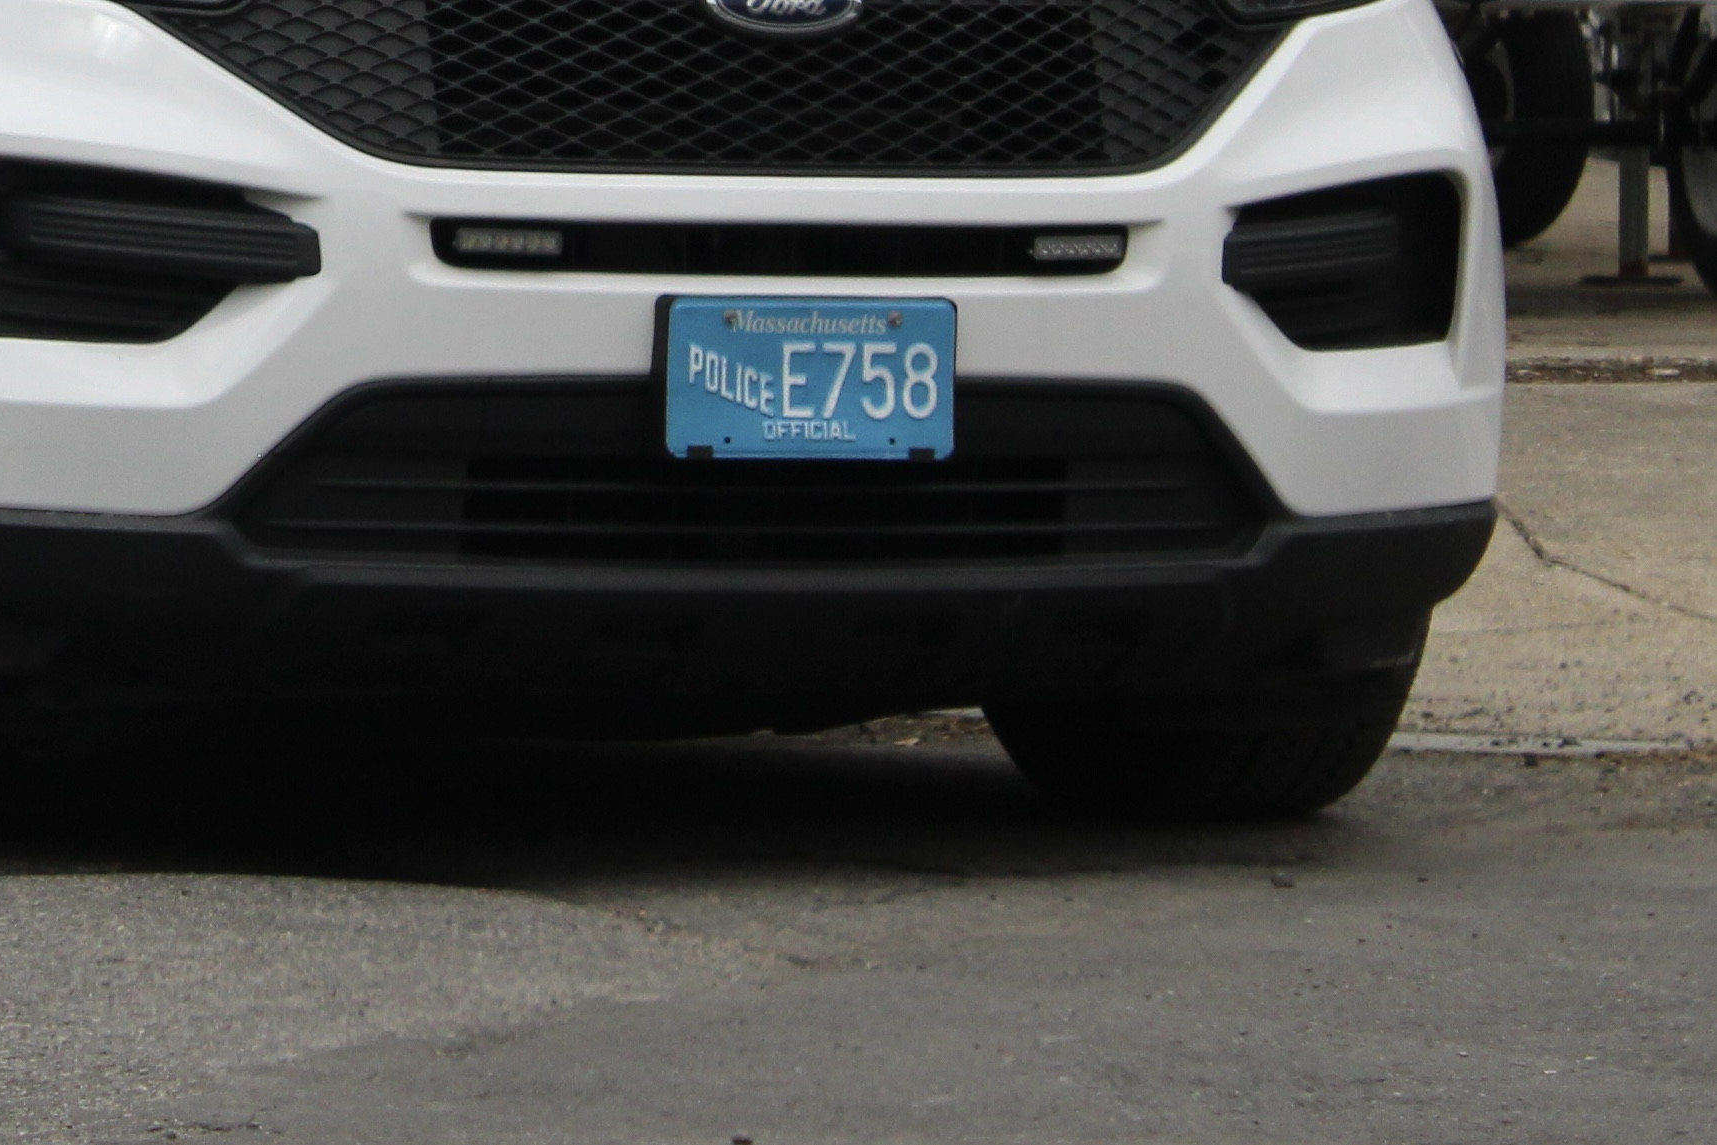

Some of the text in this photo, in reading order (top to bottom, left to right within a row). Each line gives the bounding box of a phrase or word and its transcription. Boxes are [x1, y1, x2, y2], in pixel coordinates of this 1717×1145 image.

[733, 309, 888, 334] Massachusetts
[688, 342, 939, 420] POLICE E758
[763, 420, 856, 441] OFFICIAL
